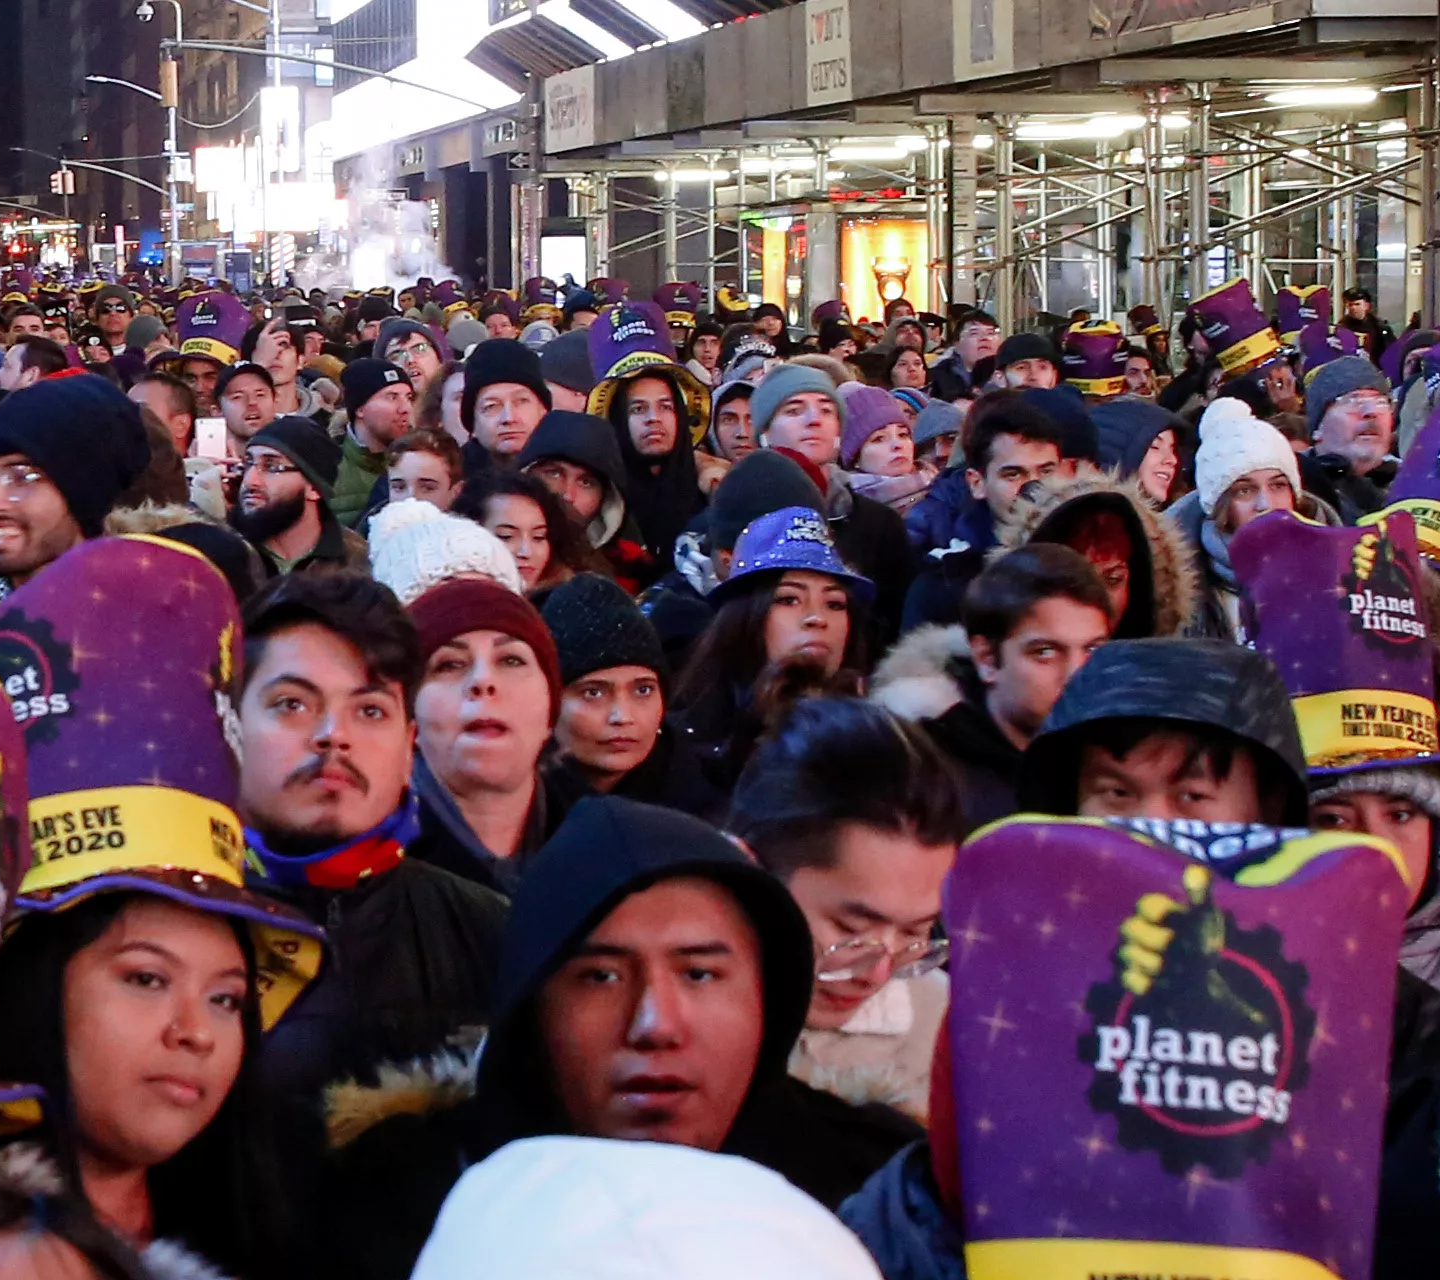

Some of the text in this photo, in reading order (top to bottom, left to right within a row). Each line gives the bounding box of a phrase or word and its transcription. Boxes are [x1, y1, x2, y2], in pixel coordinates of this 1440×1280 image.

[1348, 589, 1416, 616] planet
[1361, 610, 1427, 638] fitness
[1342, 704, 1421, 727] NEW YEAR'S
[82, 806, 122, 831] EVE
[46, 829, 127, 861] 2020
[1096, 1015, 1280, 1076] planet
[1120, 1061, 1292, 1124] fitness
